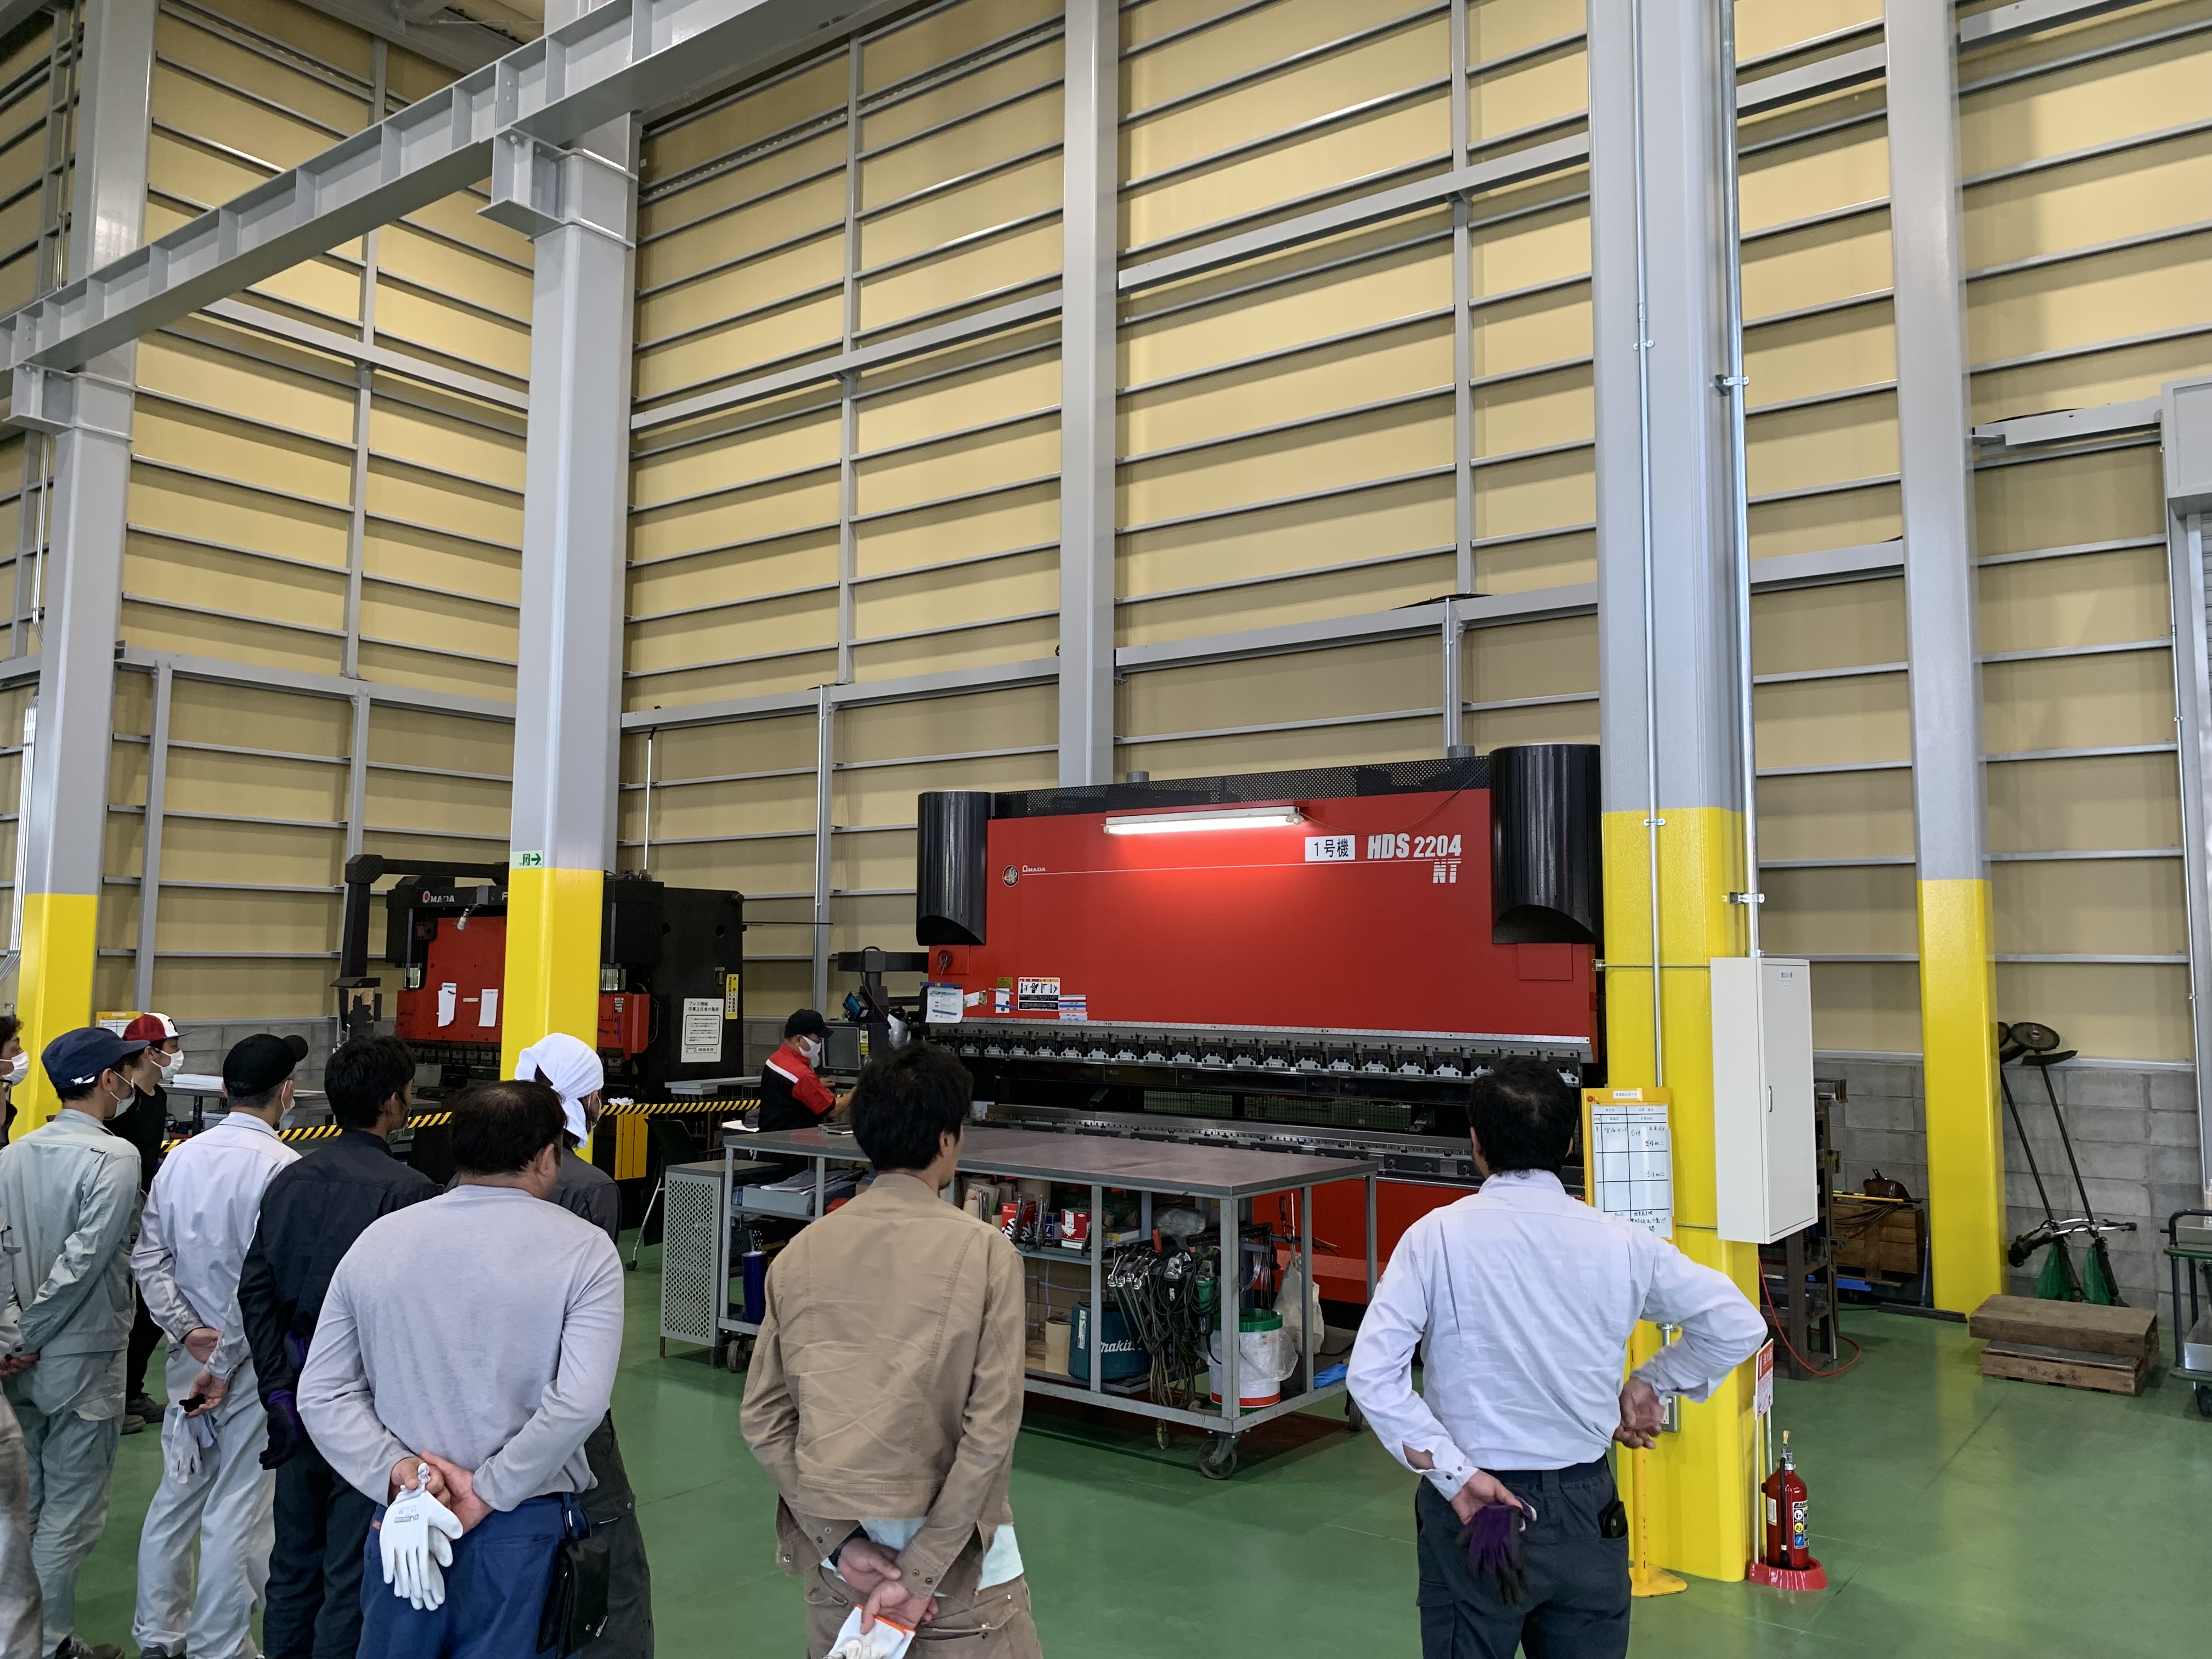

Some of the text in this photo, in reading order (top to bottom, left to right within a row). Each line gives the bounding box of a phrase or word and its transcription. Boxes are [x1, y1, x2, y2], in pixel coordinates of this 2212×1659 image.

[1314, 838, 1349, 857] 1号機
[1367, 833, 1462, 859] HDS 2204
[1432, 858, 1462, 883] NT
[1101, 1340, 1142, 1353] makit
